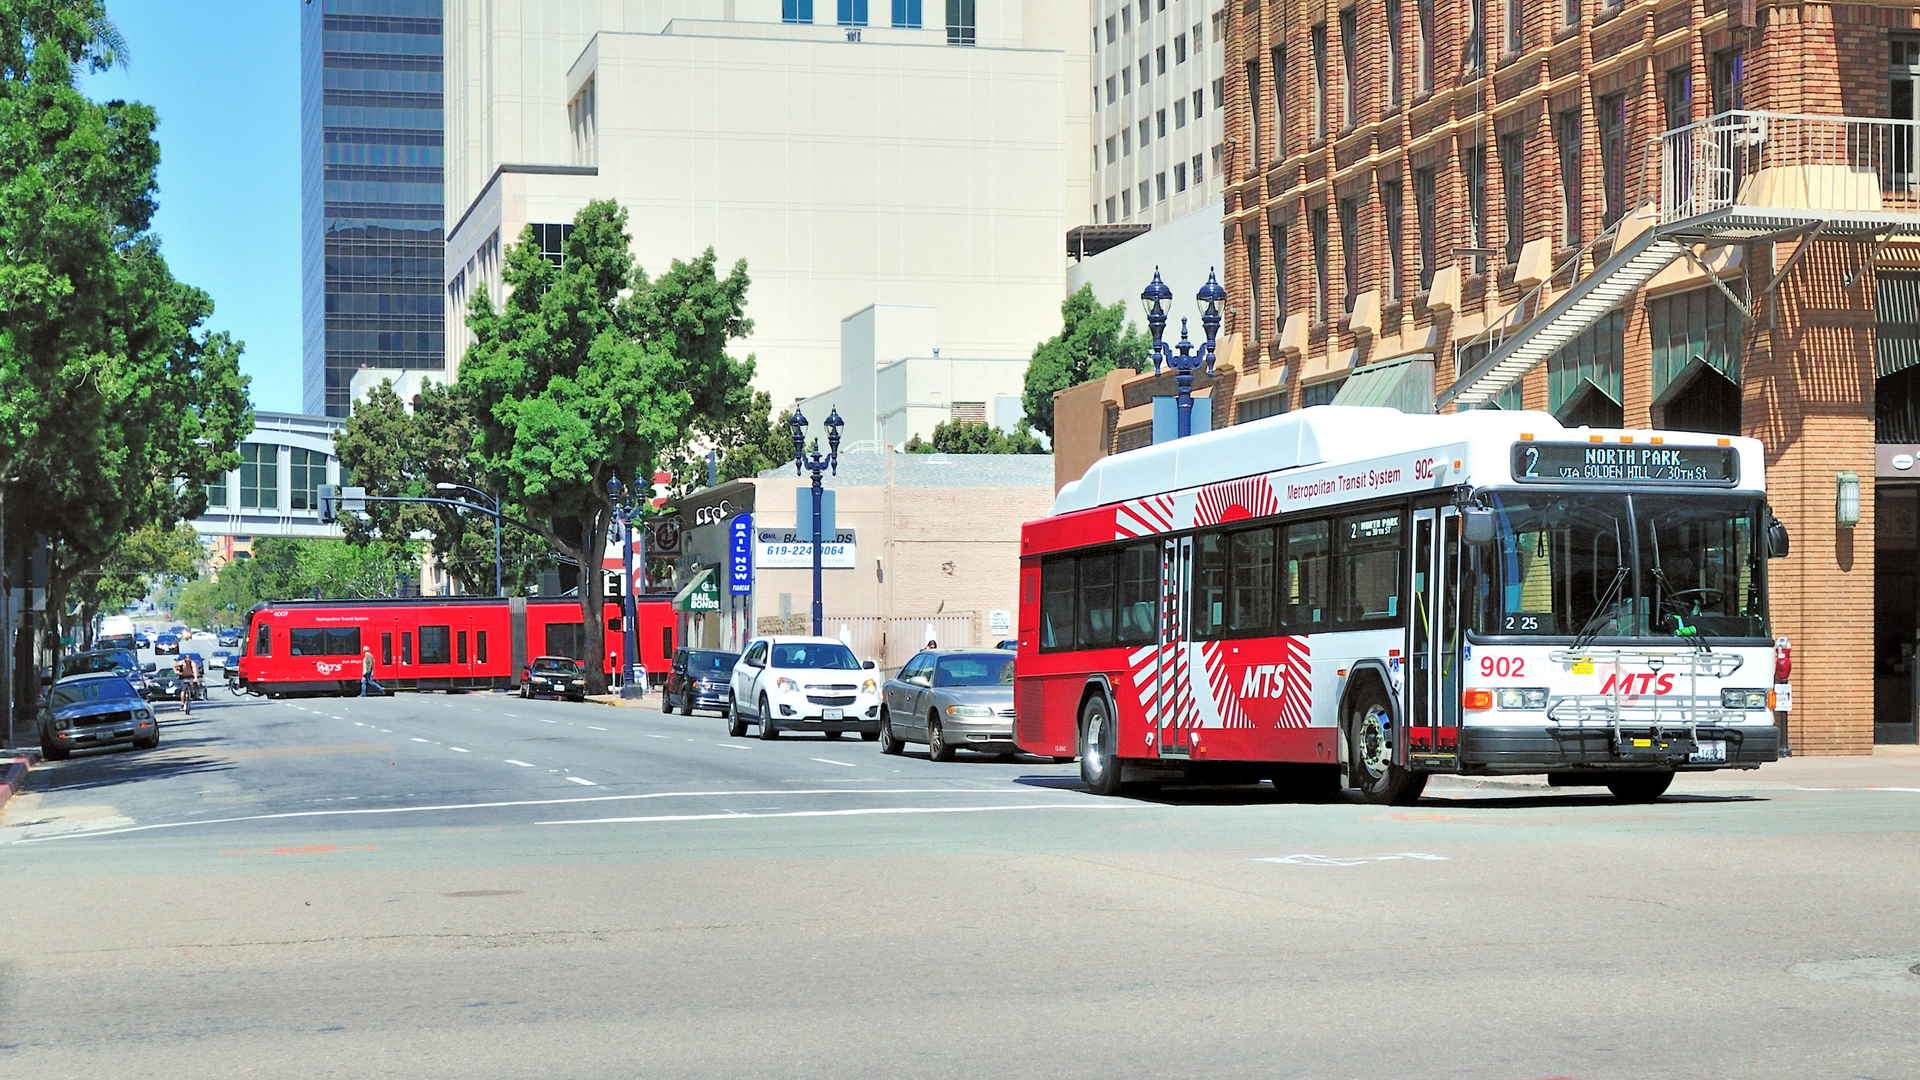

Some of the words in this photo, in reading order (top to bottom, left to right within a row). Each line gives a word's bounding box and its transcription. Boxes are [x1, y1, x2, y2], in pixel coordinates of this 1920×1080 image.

[1415, 458, 1434, 480] 902
[1526, 446, 1540, 477] 2
[1586, 448, 1636, 465] NORTH
[1642, 449, 1681, 465] PARK
[1559, 467, 1580, 478] VIA
[1584, 465, 1622, 479] GOLDEN
[1628, 466, 1651, 479] HILL
[1655, 467, 1664, 478] /
[1667, 466, 1694, 480] 30TH
[1695, 467, 1707, 480] St
[1287, 480, 1336, 500] Metropolitan
[1338, 474, 1366, 492] Transit
[1369, 468, 1401, 490] System
[735, 523, 747, 552] BAIL
[1351, 523, 1357, 538] 2
[1382, 517, 1399, 528] PARK
[784, 534, 808, 543] BA
[735, 557, 748, 580] NOW
[692, 593, 710, 601] BAIL
[1505, 616, 1515, 630] 2
[1521, 617, 1538, 630] 25
[317, 664, 342, 672] MTS
[1480, 656, 1525, 677] 902
[1240, 664, 1286, 699] MTS
[1599, 673, 1675, 695] MTS
